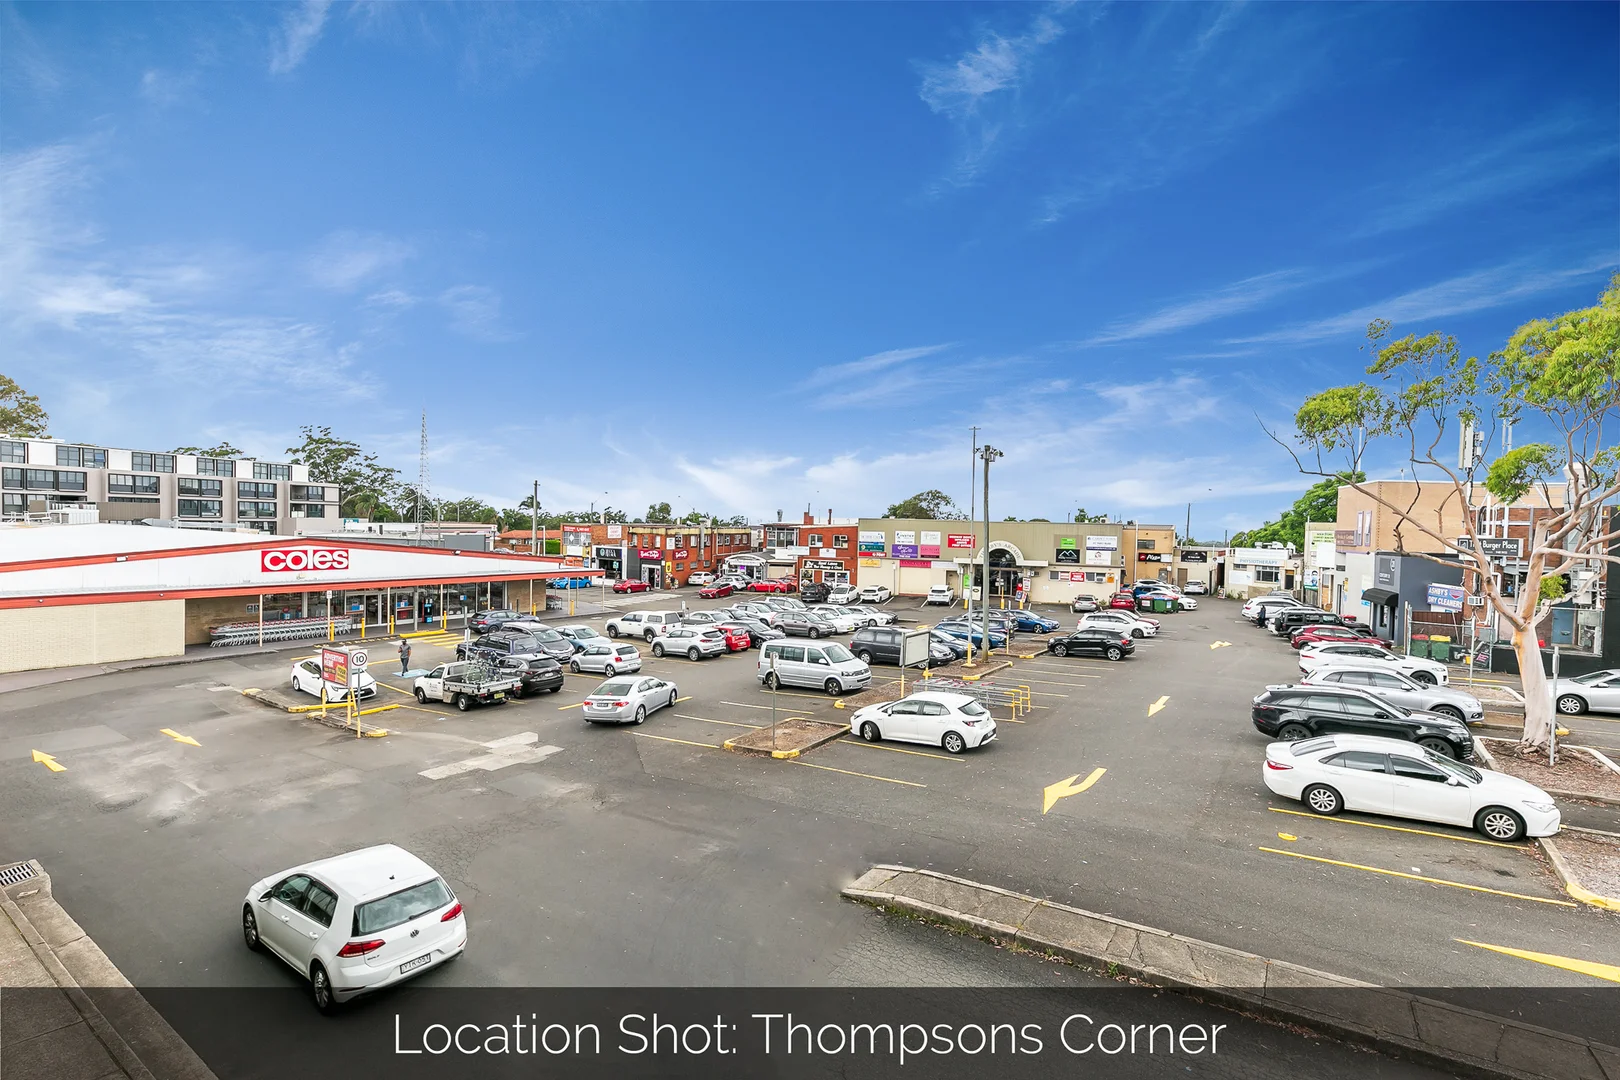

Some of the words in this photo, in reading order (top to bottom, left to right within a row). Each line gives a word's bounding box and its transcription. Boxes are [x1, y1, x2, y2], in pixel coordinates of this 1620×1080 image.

[1482, 540, 1501, 550] Burger
[1502, 540, 1518, 549] Place
[263, 549, 348, 571] coles
[1428, 586, 1448, 596] ASHBY'S
[1437, 597, 1463, 608] CLEANERS
[324, 653, 345, 664] ADVERTISE
[355, 655, 364, 663] 10
[324, 660, 334, 668] HERE
